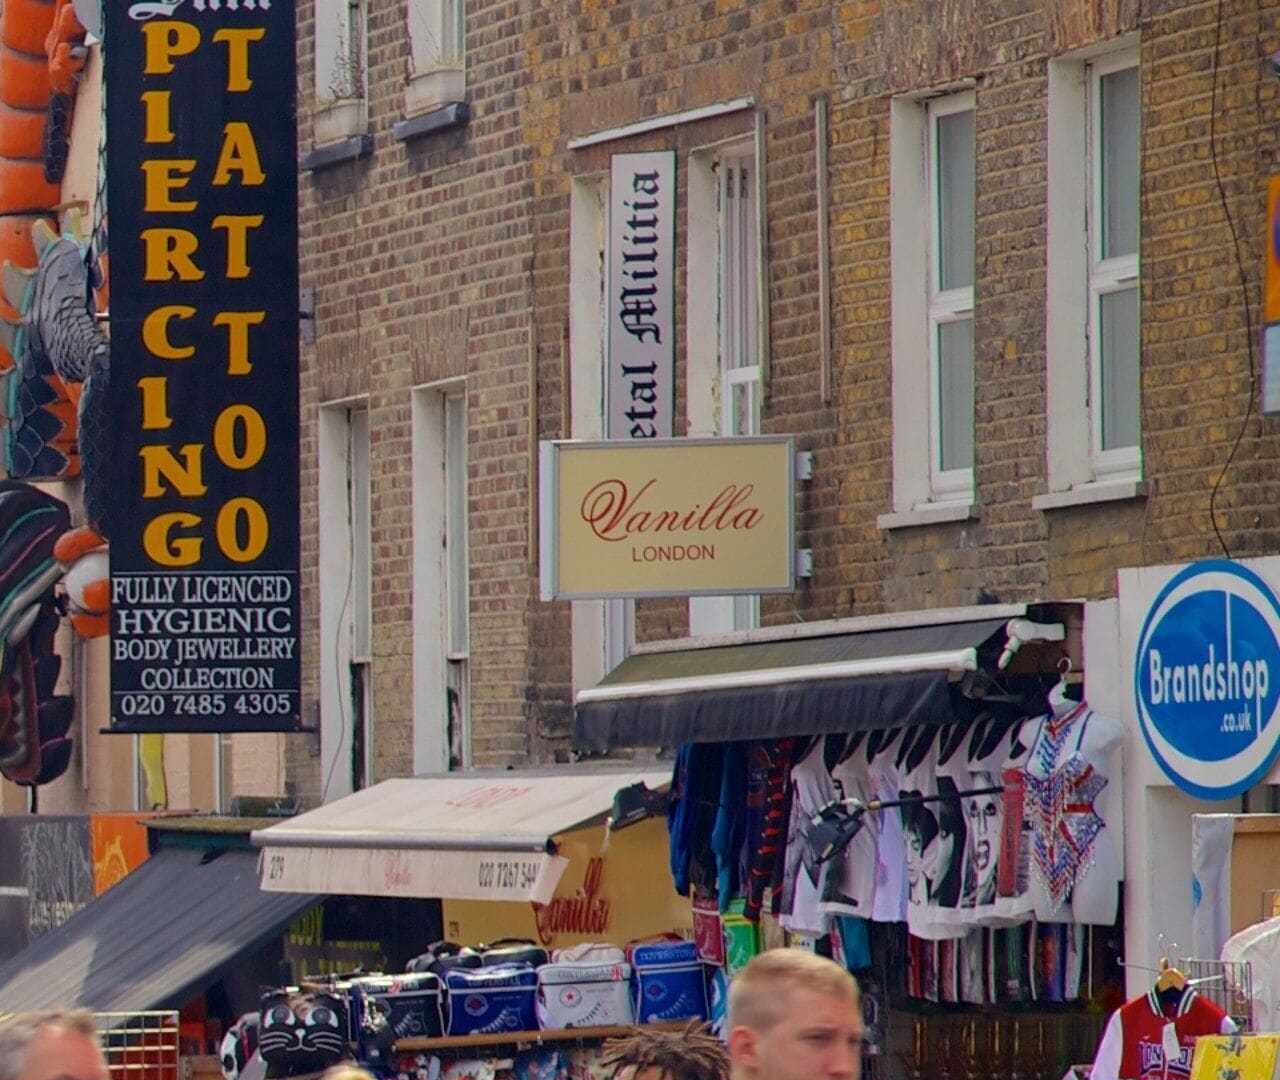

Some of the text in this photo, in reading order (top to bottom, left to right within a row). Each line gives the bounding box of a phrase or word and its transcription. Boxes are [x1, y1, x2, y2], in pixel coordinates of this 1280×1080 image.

[619, 169, 663, 344] Militia
[137, 21, 208, 567] PIERCING
[212, 28, 269, 563] TATTOO
[580, 477, 765, 542] Vanilla
[631, 544, 715, 563] LONDON
[111, 576, 292, 604] FULLY LICENCED
[118, 607, 292, 634] HYGIENIC
[114, 637, 296, 666] BODY JEWELLERY
[141, 667, 275, 689] COLLECTION
[121, 694, 290, 715] 020 7485 4305
[1220, 703, 1251, 732] .co.uk
[270, 855, 284, 879] 279
